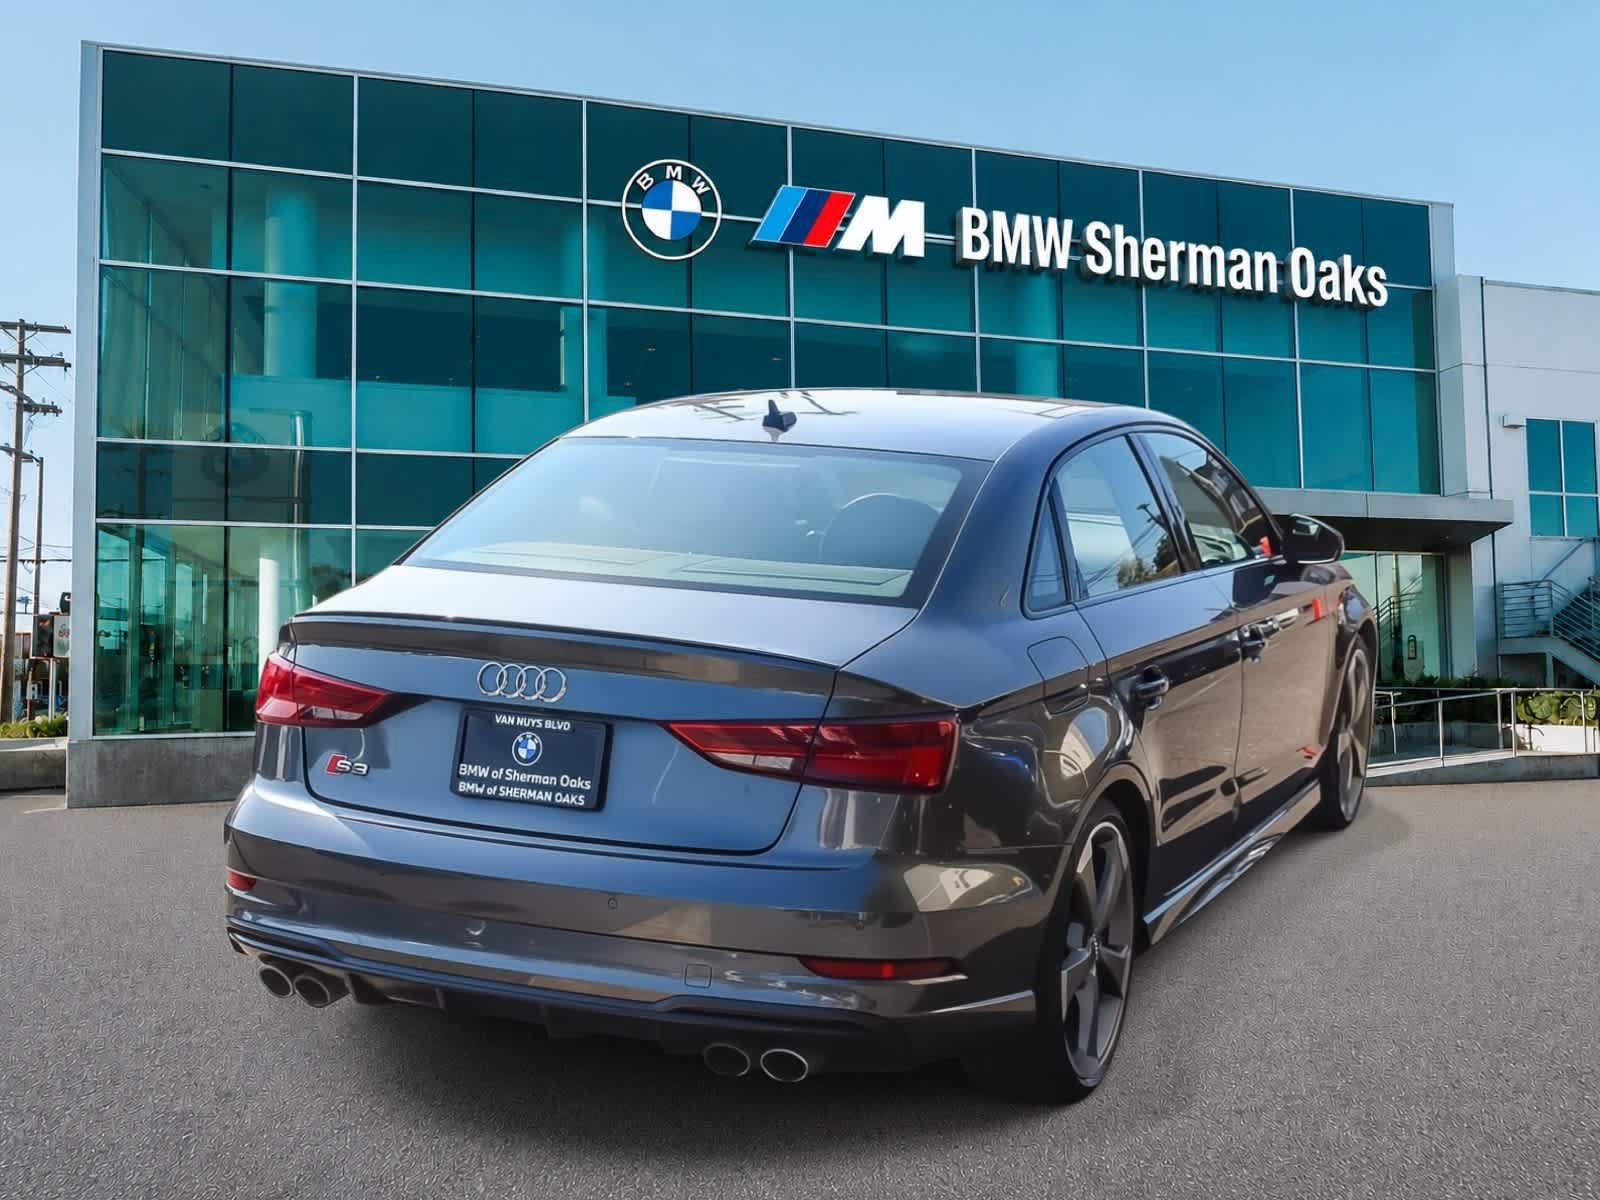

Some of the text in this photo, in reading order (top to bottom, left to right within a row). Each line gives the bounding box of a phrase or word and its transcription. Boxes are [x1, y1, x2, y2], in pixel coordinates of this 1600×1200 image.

[635, 165, 711, 196] BMW
[960, 206, 1389, 309] BMW Sherman Oaks
[495, 713, 571, 732] VAN NUYS BLVD
[336, 759, 369, 776] S3
[458, 763, 592, 791] BMW of Sherman Oaks
[458, 781, 586, 806] BMW of SHERMAN OAKS
